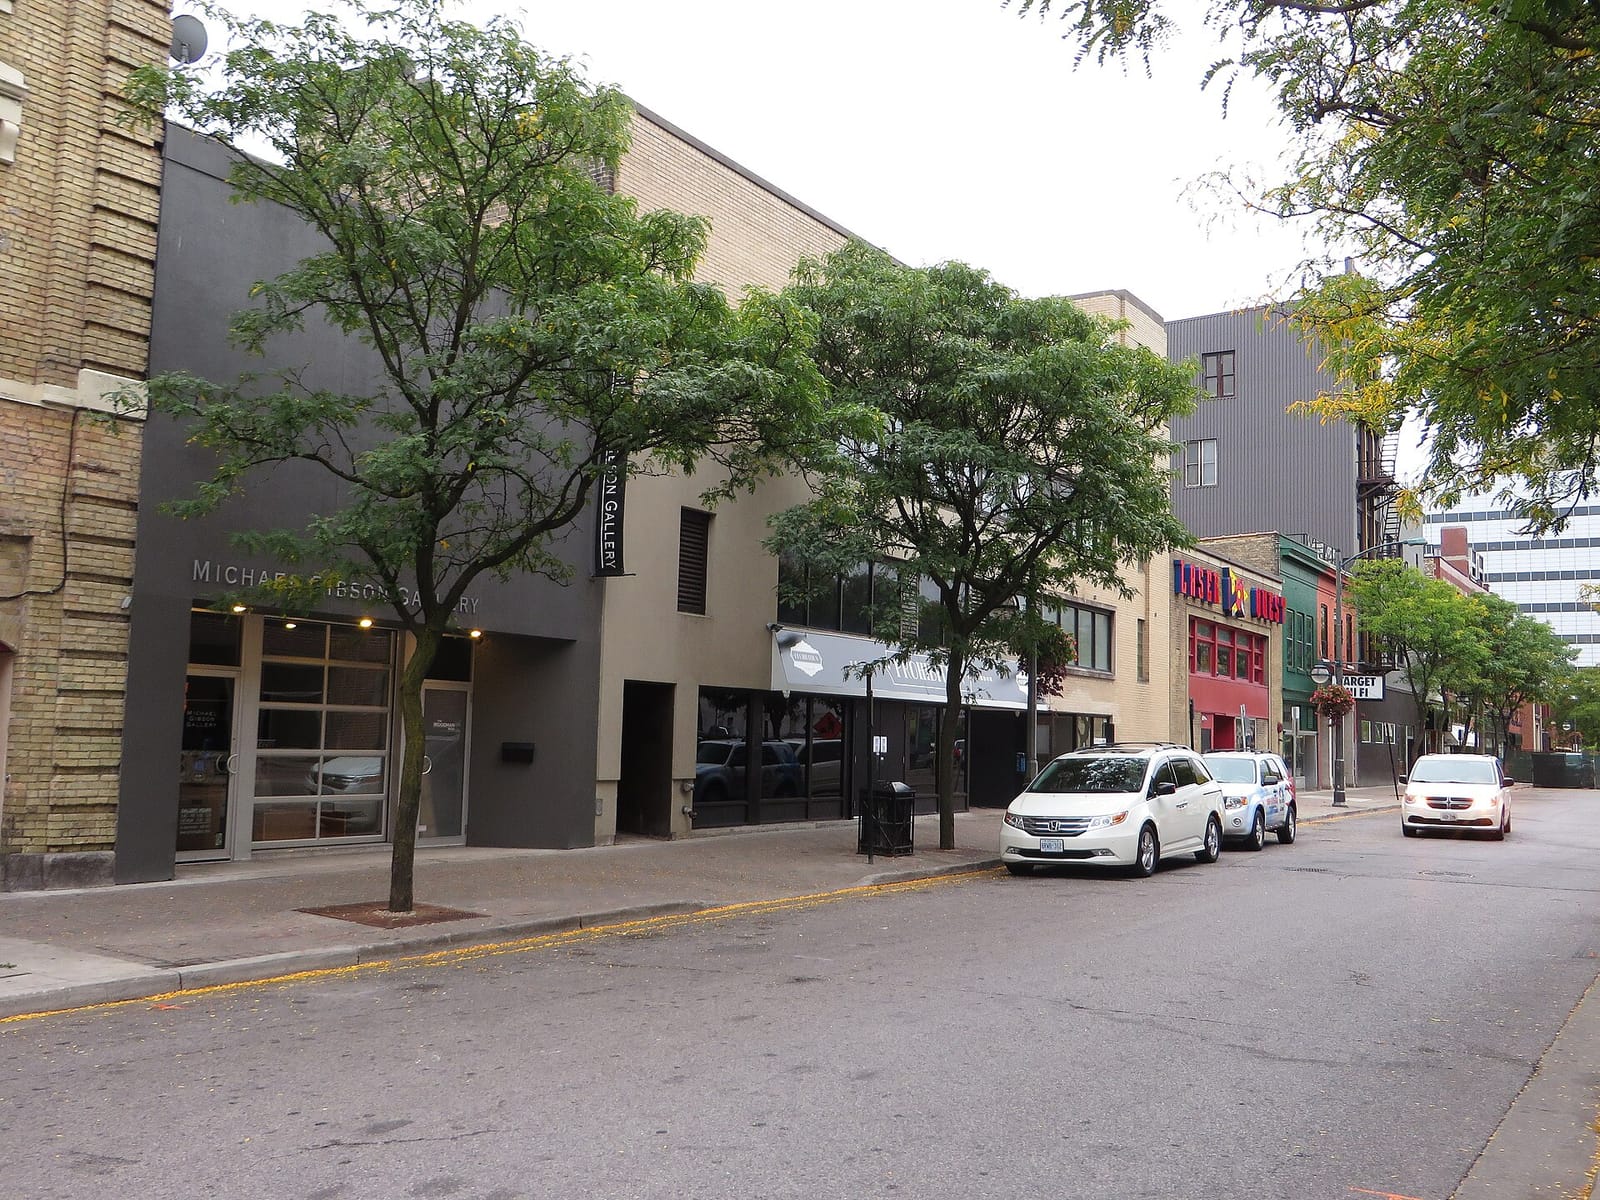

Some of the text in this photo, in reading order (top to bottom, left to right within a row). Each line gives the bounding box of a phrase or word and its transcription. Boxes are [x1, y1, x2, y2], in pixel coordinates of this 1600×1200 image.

[604, 500, 618, 568] GALLERY
[1174, 560, 1286, 624] LASER QUEST
[1342, 676, 1376, 687] ARGET
[1359, 687, 1369, 698] FI
